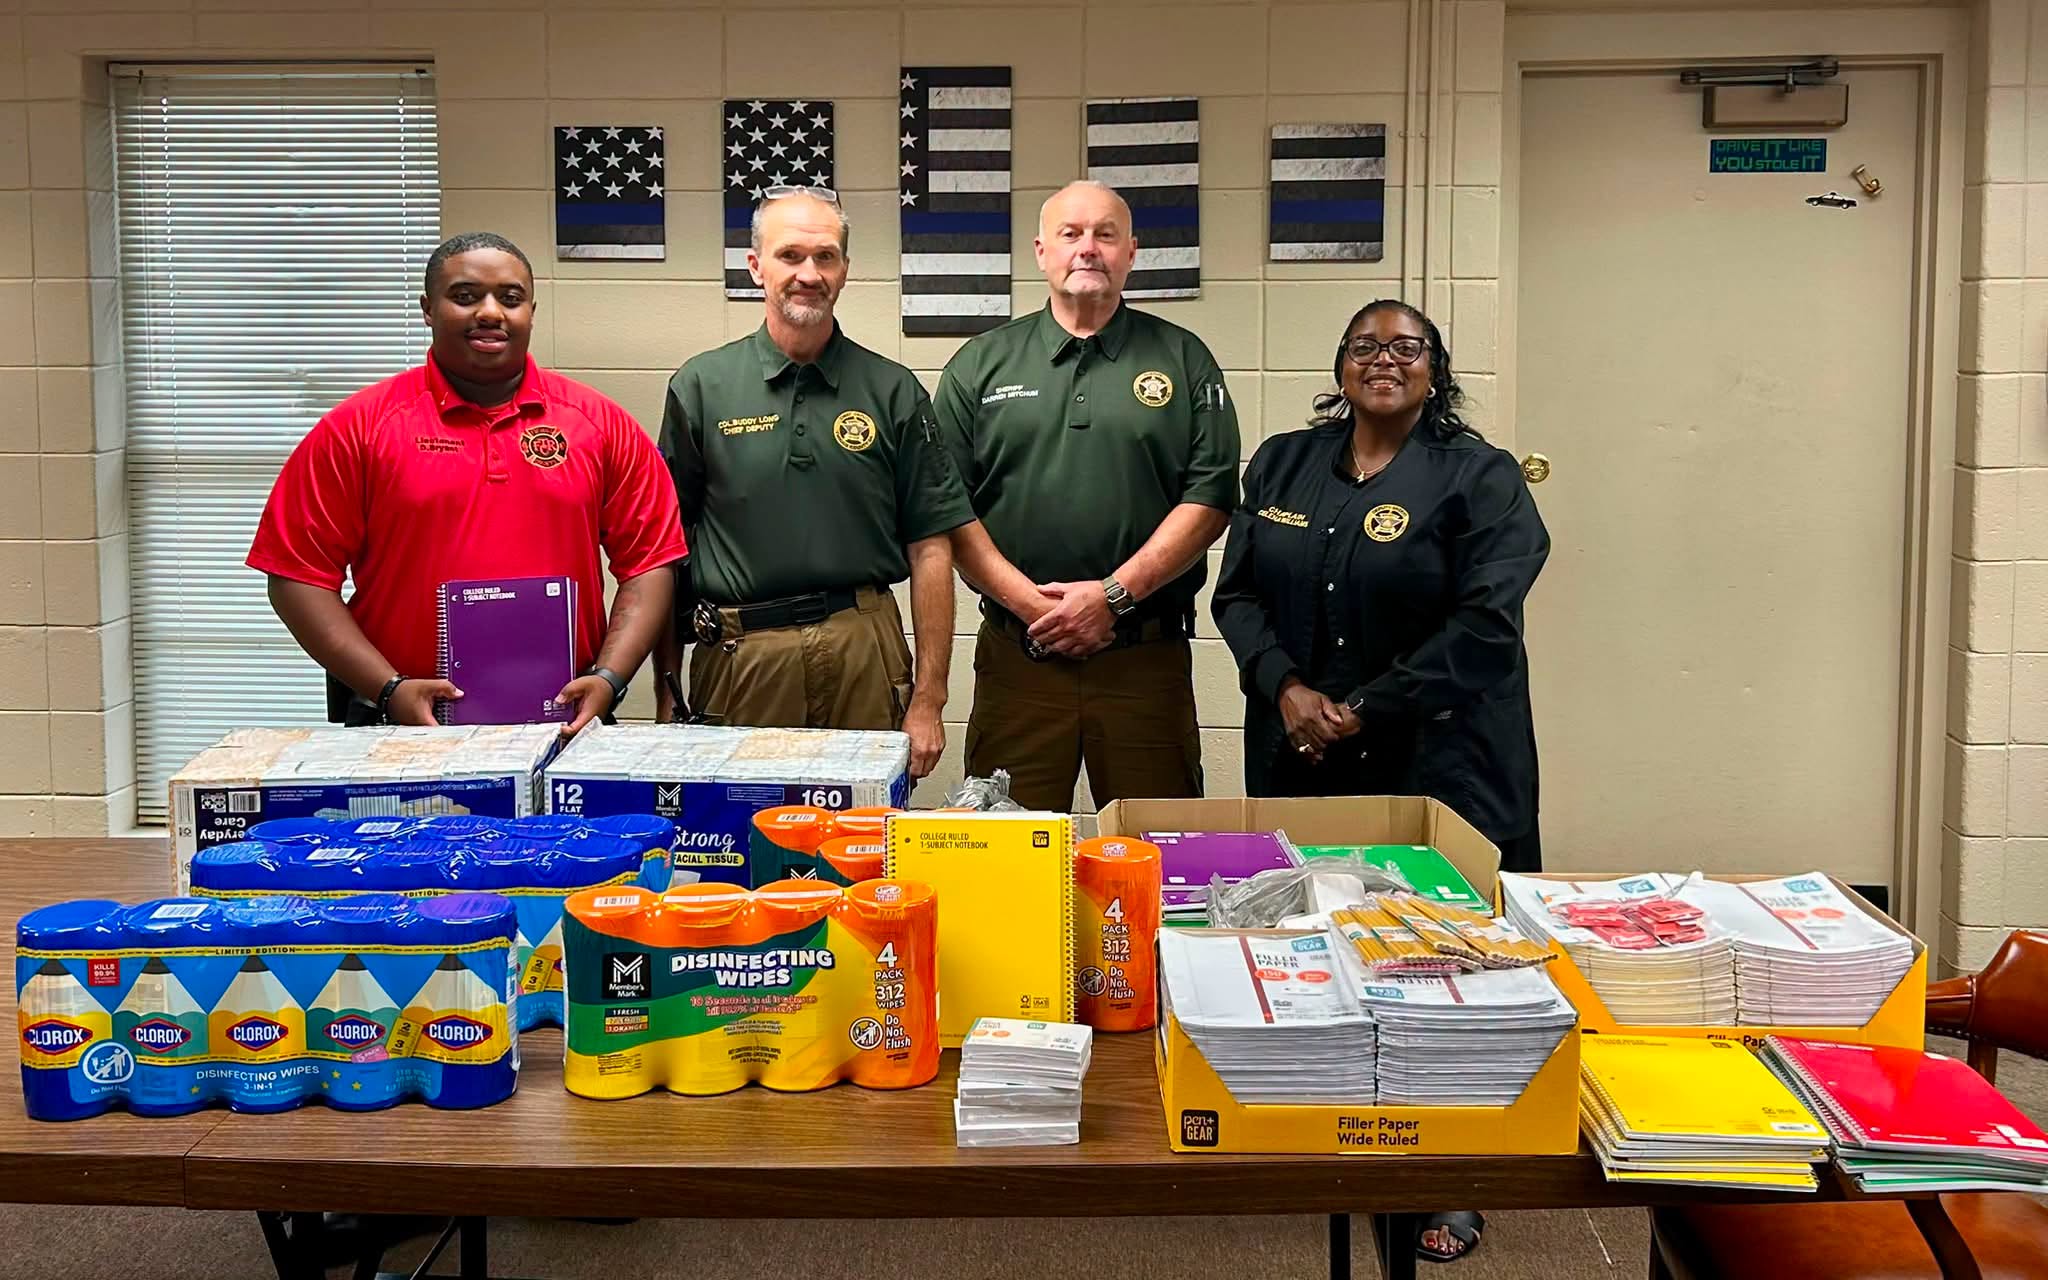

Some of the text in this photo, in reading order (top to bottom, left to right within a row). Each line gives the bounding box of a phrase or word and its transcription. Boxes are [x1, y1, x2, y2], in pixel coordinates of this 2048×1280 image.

[1716, 140, 1821, 158] DRIVE IT LIKE
[1715, 155, 1821, 170] YOU STOLE IT
[995, 384, 1024, 394] SHERIFF
[758, 414, 780, 424] LONG
[723, 423, 775, 436] CHIEF DEPUTY
[414, 436, 465, 446] Lieutenant
[419, 444, 459, 453] D.Bryant
[1268, 506, 1306, 520] CHAPLAIN
[484, 586, 501, 594] RULED
[554, 783, 584, 804] 12
[801, 789, 843, 808] 160
[214, 817, 246, 828] Care
[199, 829, 246, 842] eryday
[673, 825, 736, 853] Strong
[919, 832, 970, 841] COLLEGE RULED
[919, 841, 989, 849] 1-SUBJECT NOTEBOOK
[705, 854, 739, 864] TISSUE
[403, 890, 439, 898] EDITION
[1104, 898, 1125, 924] 4
[1102, 925, 1129, 934] PACK
[1102, 938, 1130, 954] 312
[671, 949, 833, 973] DISINFECTING
[876, 942, 898, 968] 4
[1103, 954, 1130, 962] WIPES
[1255, 953, 1298, 962] FILLER
[1257, 960, 1300, 968] PAPER
[715, 968, 791, 987] WIPES
[875, 968, 904, 980] PACK
[1110, 966, 1123, 977] Do
[528, 975, 538, 984] 3
[1109, 978, 1128, 989] Not
[608, 983, 645, 991] Member's
[876, 983, 905, 1000] 312
[1108, 989, 1135, 999] Flush
[877, 999, 905, 1009] WIPES
[885, 1014, 899, 1026] Do
[233, 1024, 281, 1041] CLOROX
[330, 1023, 378, 1040] CLOROX
[402, 1022, 412, 1031] 2
[429, 1022, 485, 1040] CLOROX
[613, 1024, 643, 1033] ORANGE
[885, 1026, 904, 1038] Not
[29, 1028, 84, 1045] CLOROX
[135, 1027, 183, 1043] CLOROX
[394, 1039, 405, 1048] 3
[884, 1037, 911, 1050] Flush
[1743, 1035, 1767, 1049] Pap
[196, 1065, 320, 1081] DISINFECTING WIPES
[243, 1082, 273, 1090] 3-IN-1
[1183, 1115, 1215, 1130] pen+
[1337, 1116, 1419, 1132] Filler Paper
[1186, 1126, 1213, 1141] GEAR
[1337, 1132, 1419, 1146] Wide Ruled
